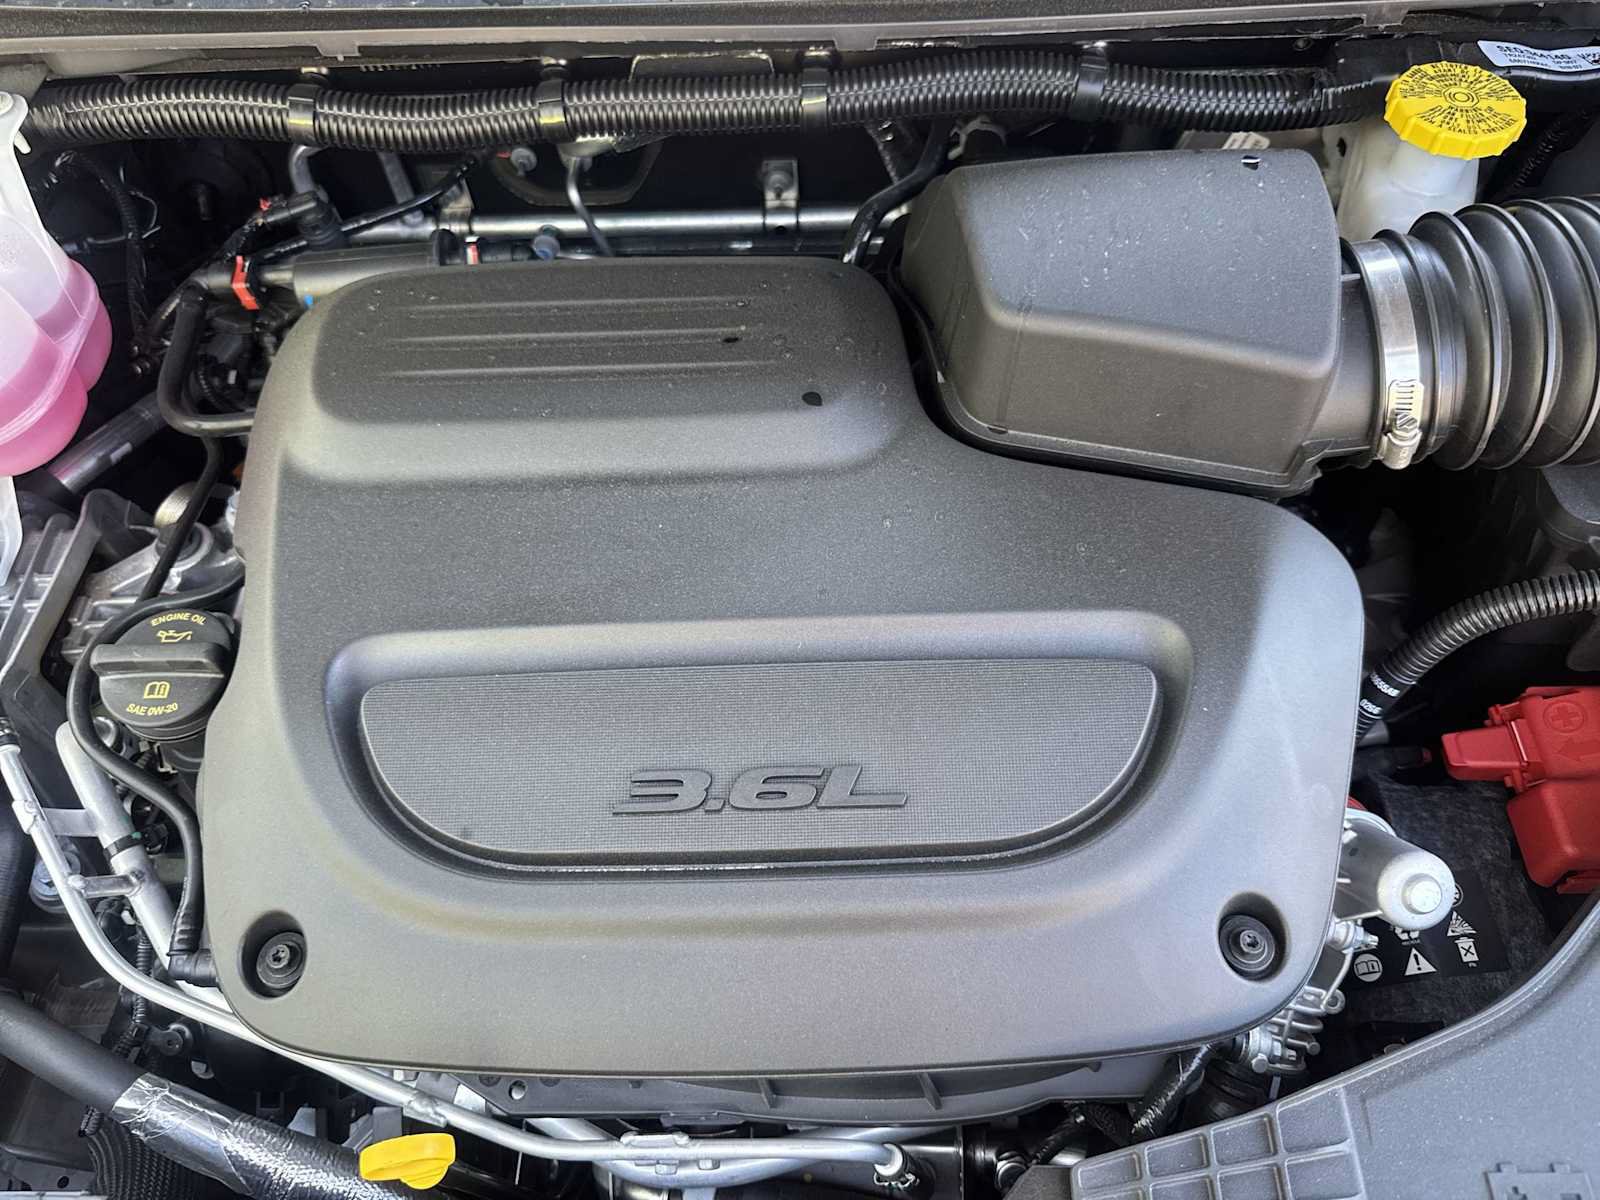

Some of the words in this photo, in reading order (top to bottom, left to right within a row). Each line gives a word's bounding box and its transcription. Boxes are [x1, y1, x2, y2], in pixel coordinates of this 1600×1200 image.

[151, 612, 191, 626] ENGINE
[191, 614, 206, 626] OIL
[126, 703, 147, 716] SAE
[147, 702, 178, 716] 0W-20
[612, 764, 908, 815] 3.6L
